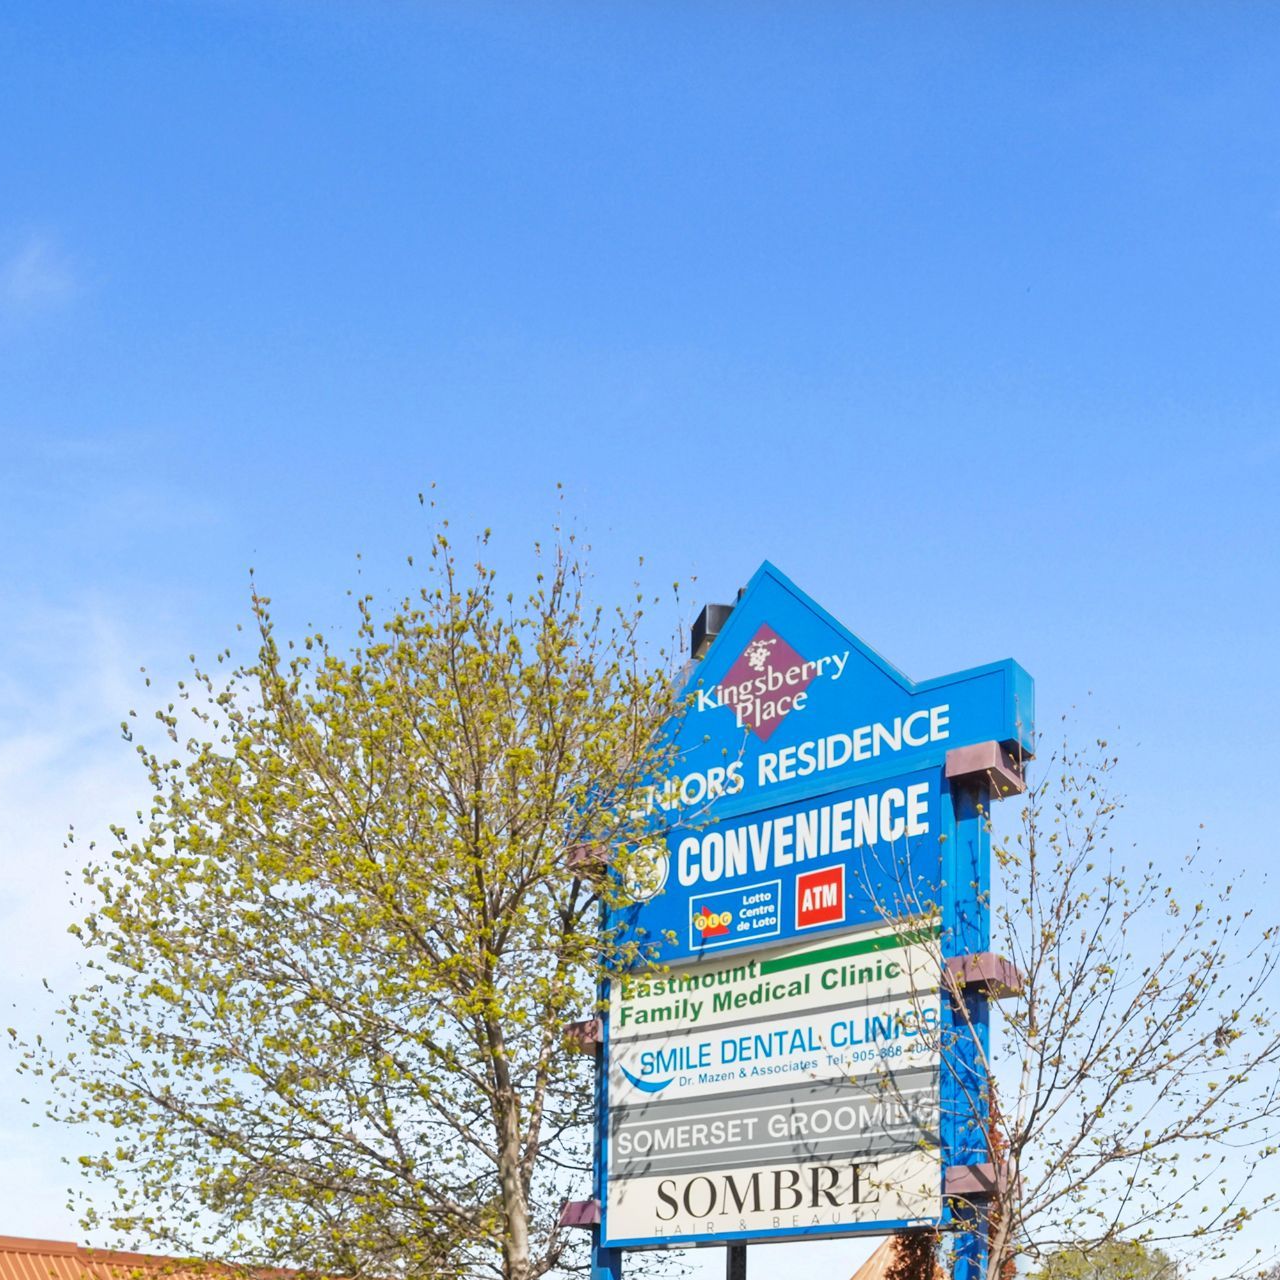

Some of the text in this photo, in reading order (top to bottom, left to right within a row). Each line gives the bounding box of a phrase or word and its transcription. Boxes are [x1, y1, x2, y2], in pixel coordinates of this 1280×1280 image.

[698, 651, 850, 712] Kingsberry
[735, 691, 808, 729] Place
[613, 704, 950, 823] ENIORS RESIDENCE
[678, 782, 929, 887] CONVENIENCE
[739, 904, 775, 919] Centre
[743, 892, 772, 906] Lotto
[802, 883, 838, 913] ATM
[696, 913, 731, 929] OLG
[737, 916, 777, 931] de Loto
[620, 959, 757, 1001] Eastmount
[620, 959, 902, 1027] Family Medical Clinic
[640, 1008, 938, 1076] SMILE DENTAL CLINICS
[679, 1076, 695, 1087] Dr.
[698, 1070, 735, 1084] Mazen
[738, 1067, 747, 1079] &
[750, 1058, 819, 1077] Associates
[618, 1097, 938, 1155] SOMERSET GROOMING
[655, 1162, 880, 1221] SOMBRE
[655, 1221, 714, 1237] HAIR
[739, 1218, 748, 1231] &
